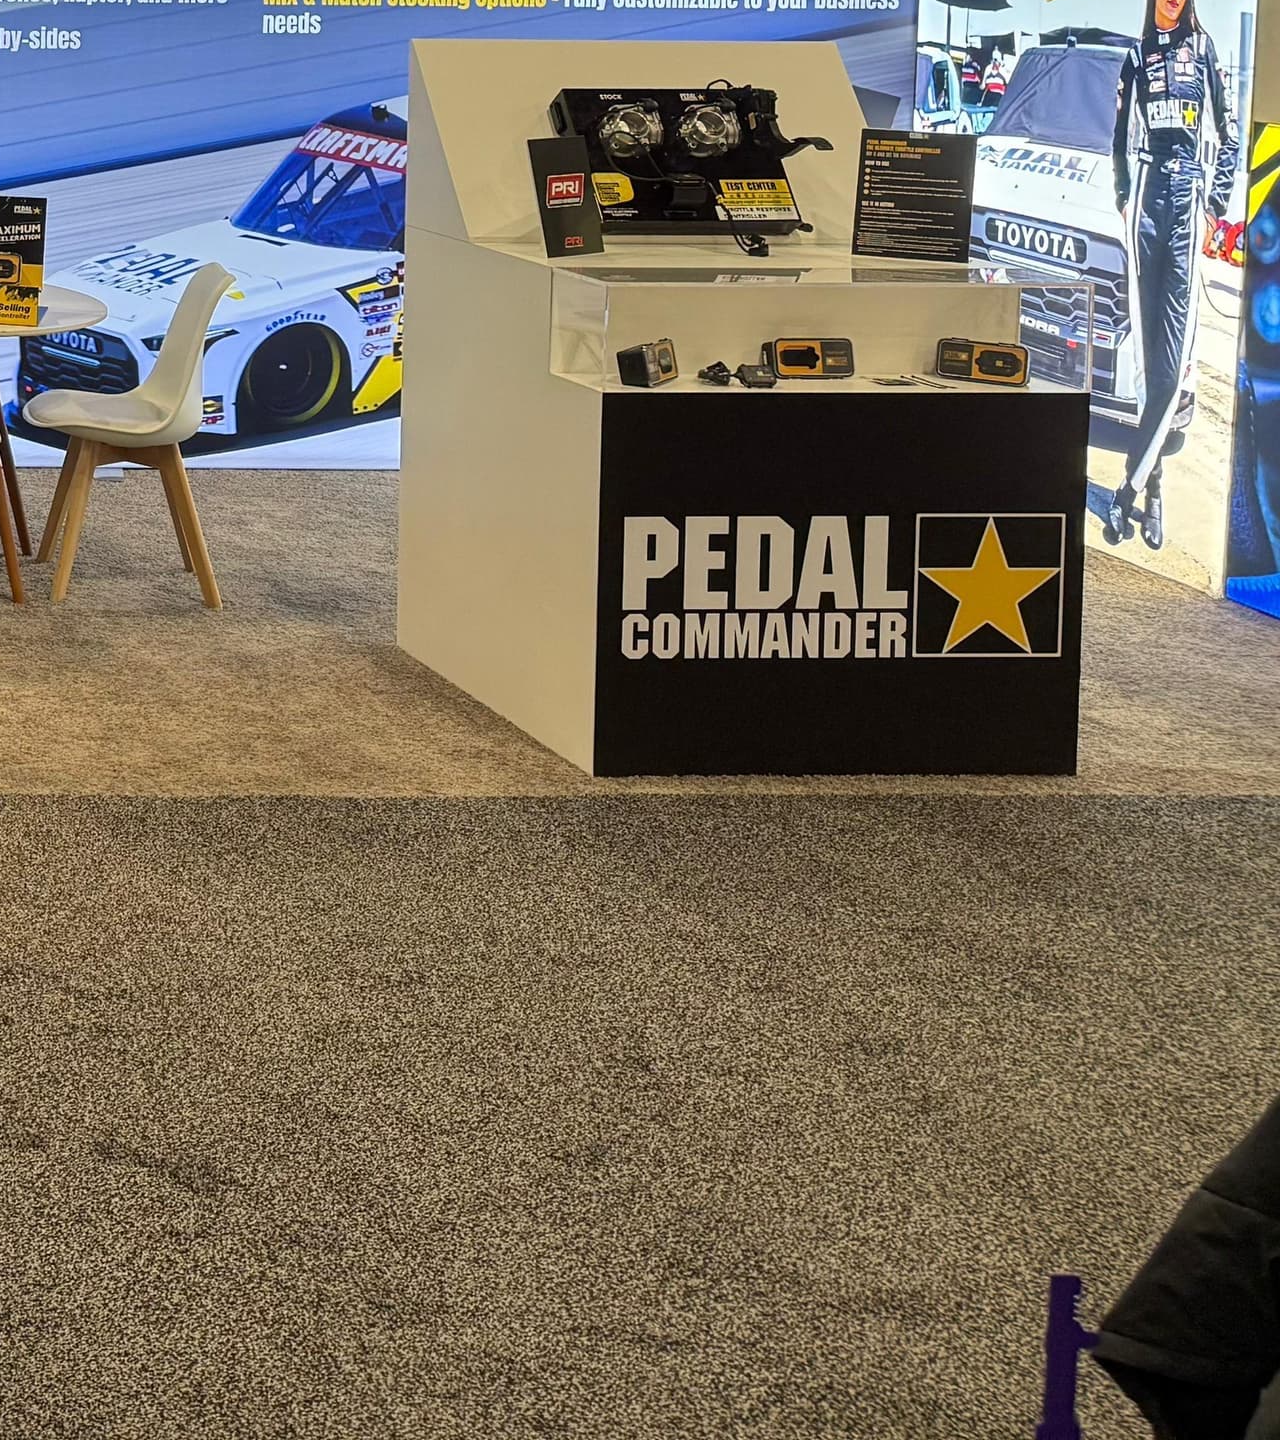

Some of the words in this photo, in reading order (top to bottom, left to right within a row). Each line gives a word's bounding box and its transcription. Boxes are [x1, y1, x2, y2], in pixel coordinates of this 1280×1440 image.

[551, 180, 580, 197] PRI
[725, 182, 743, 191] TEST
[746, 182, 777, 191] CENTER
[565, 236, 584, 247] PRI
[994, 218, 1078, 262] TOYOTA
[621, 515, 908, 611] PEDAL
[620, 611, 907, 660] COMMANDER
